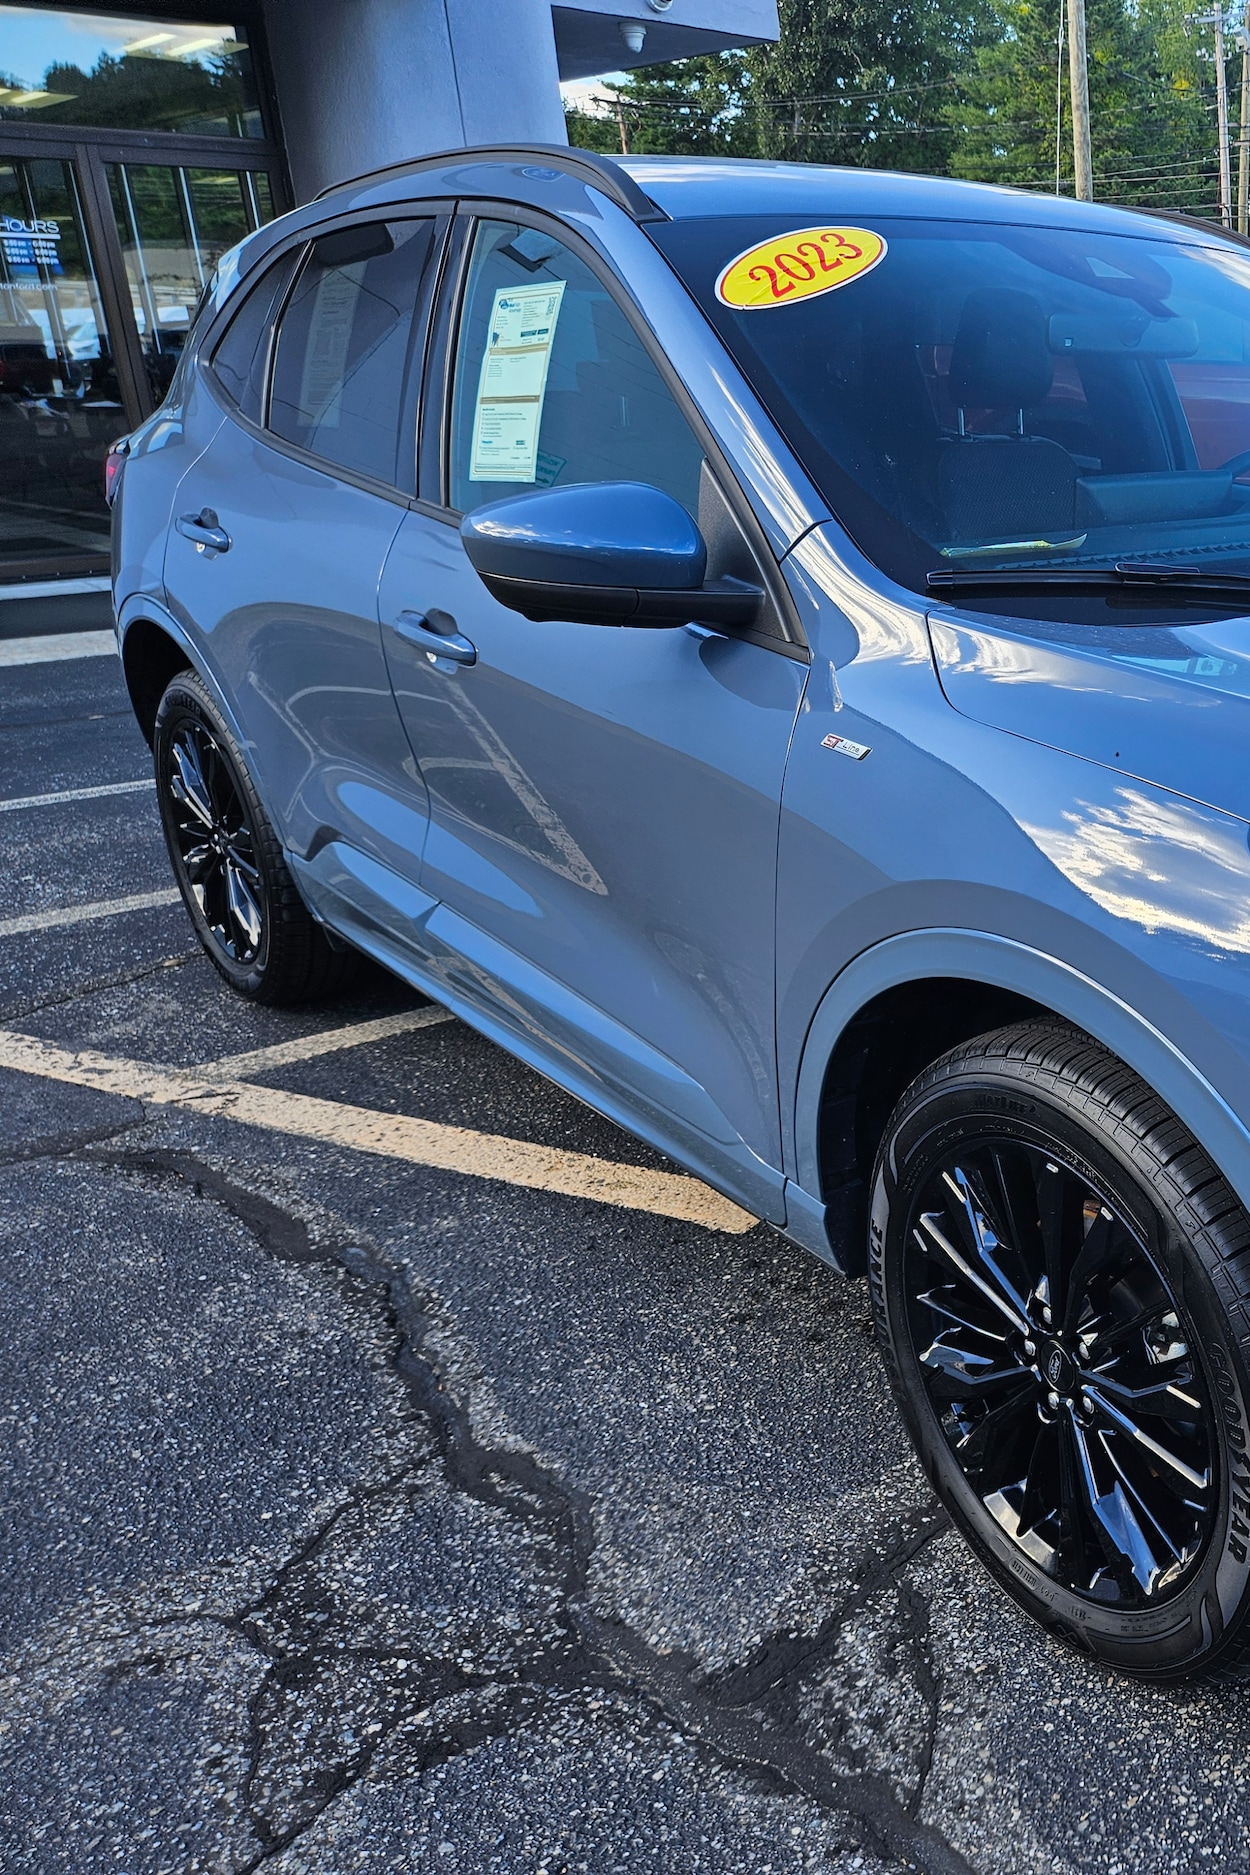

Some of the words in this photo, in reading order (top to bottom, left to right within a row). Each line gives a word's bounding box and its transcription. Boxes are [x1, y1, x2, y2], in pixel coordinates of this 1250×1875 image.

[0, 219, 60, 233] HOURS
[748, 233, 863, 298] 2023
[842, 741, 861, 753] Line
